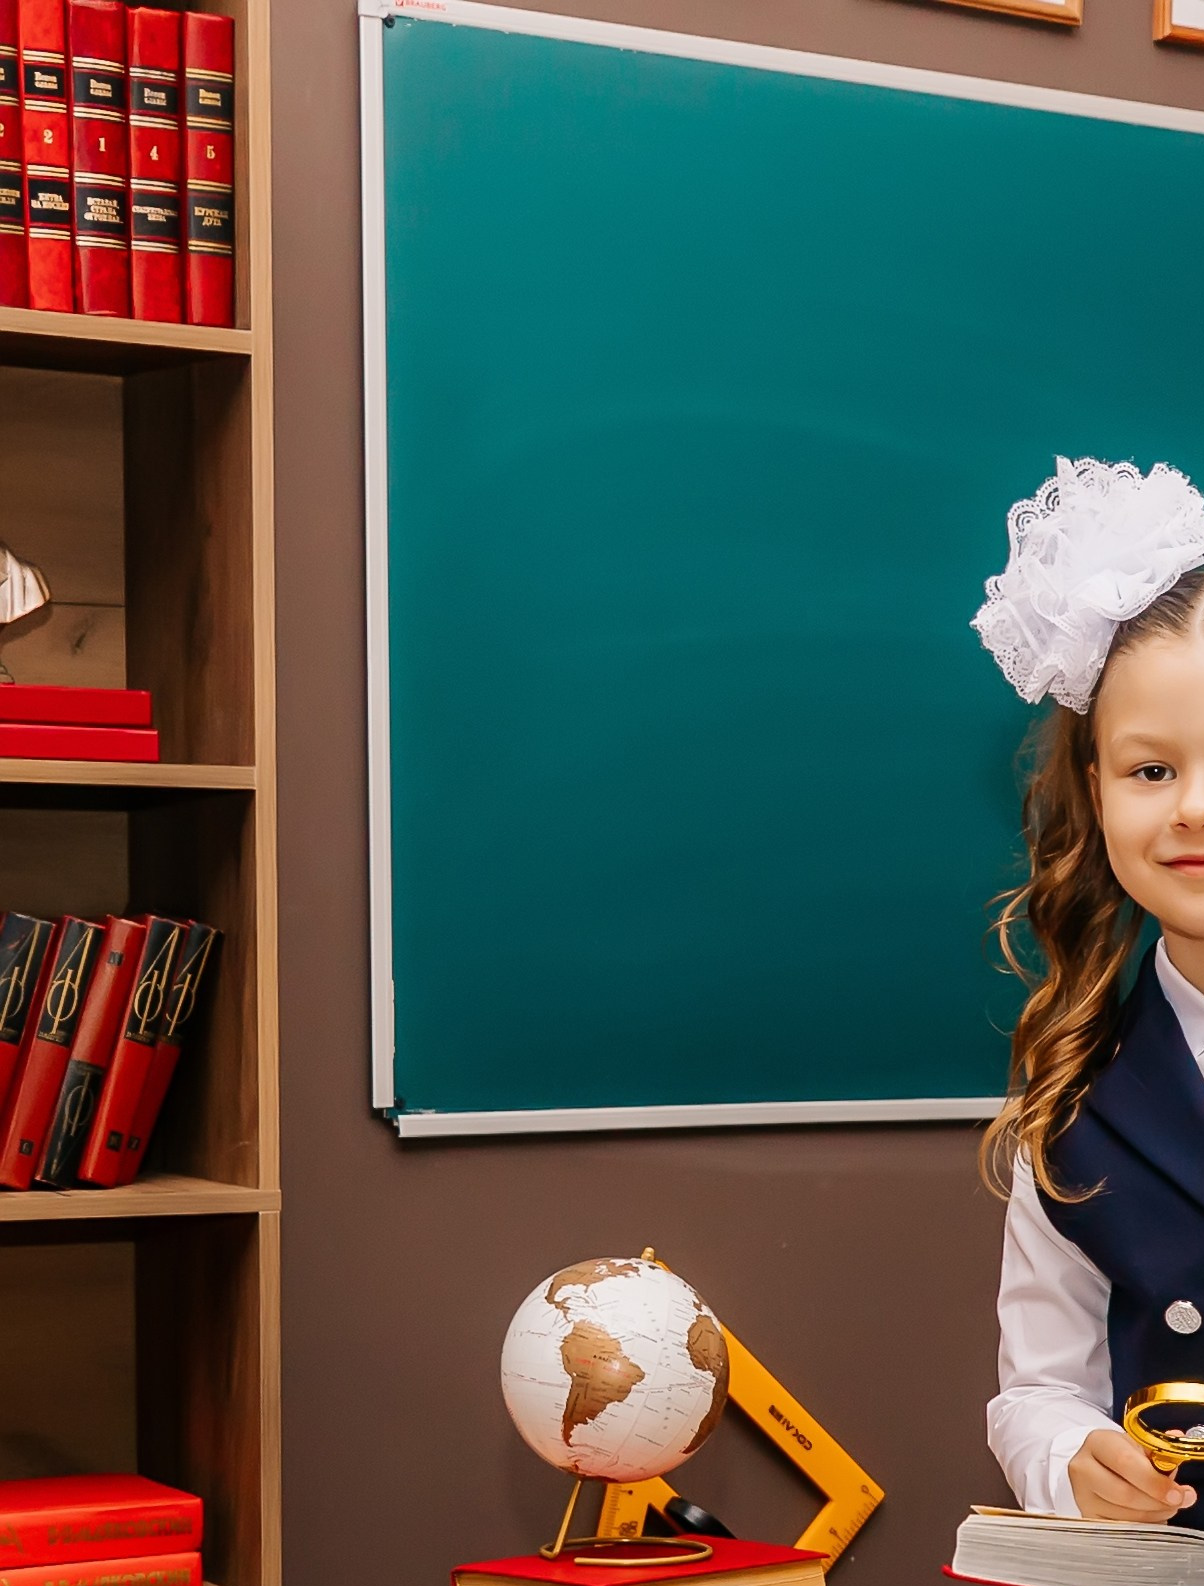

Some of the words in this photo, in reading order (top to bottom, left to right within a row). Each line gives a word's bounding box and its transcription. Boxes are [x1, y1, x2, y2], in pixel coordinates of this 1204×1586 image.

[43, 129, 54, 144] 2
[98, 137, 106, 152] 1
[206, 144, 216, 160] 5
[149, 145, 159, 161] 4
